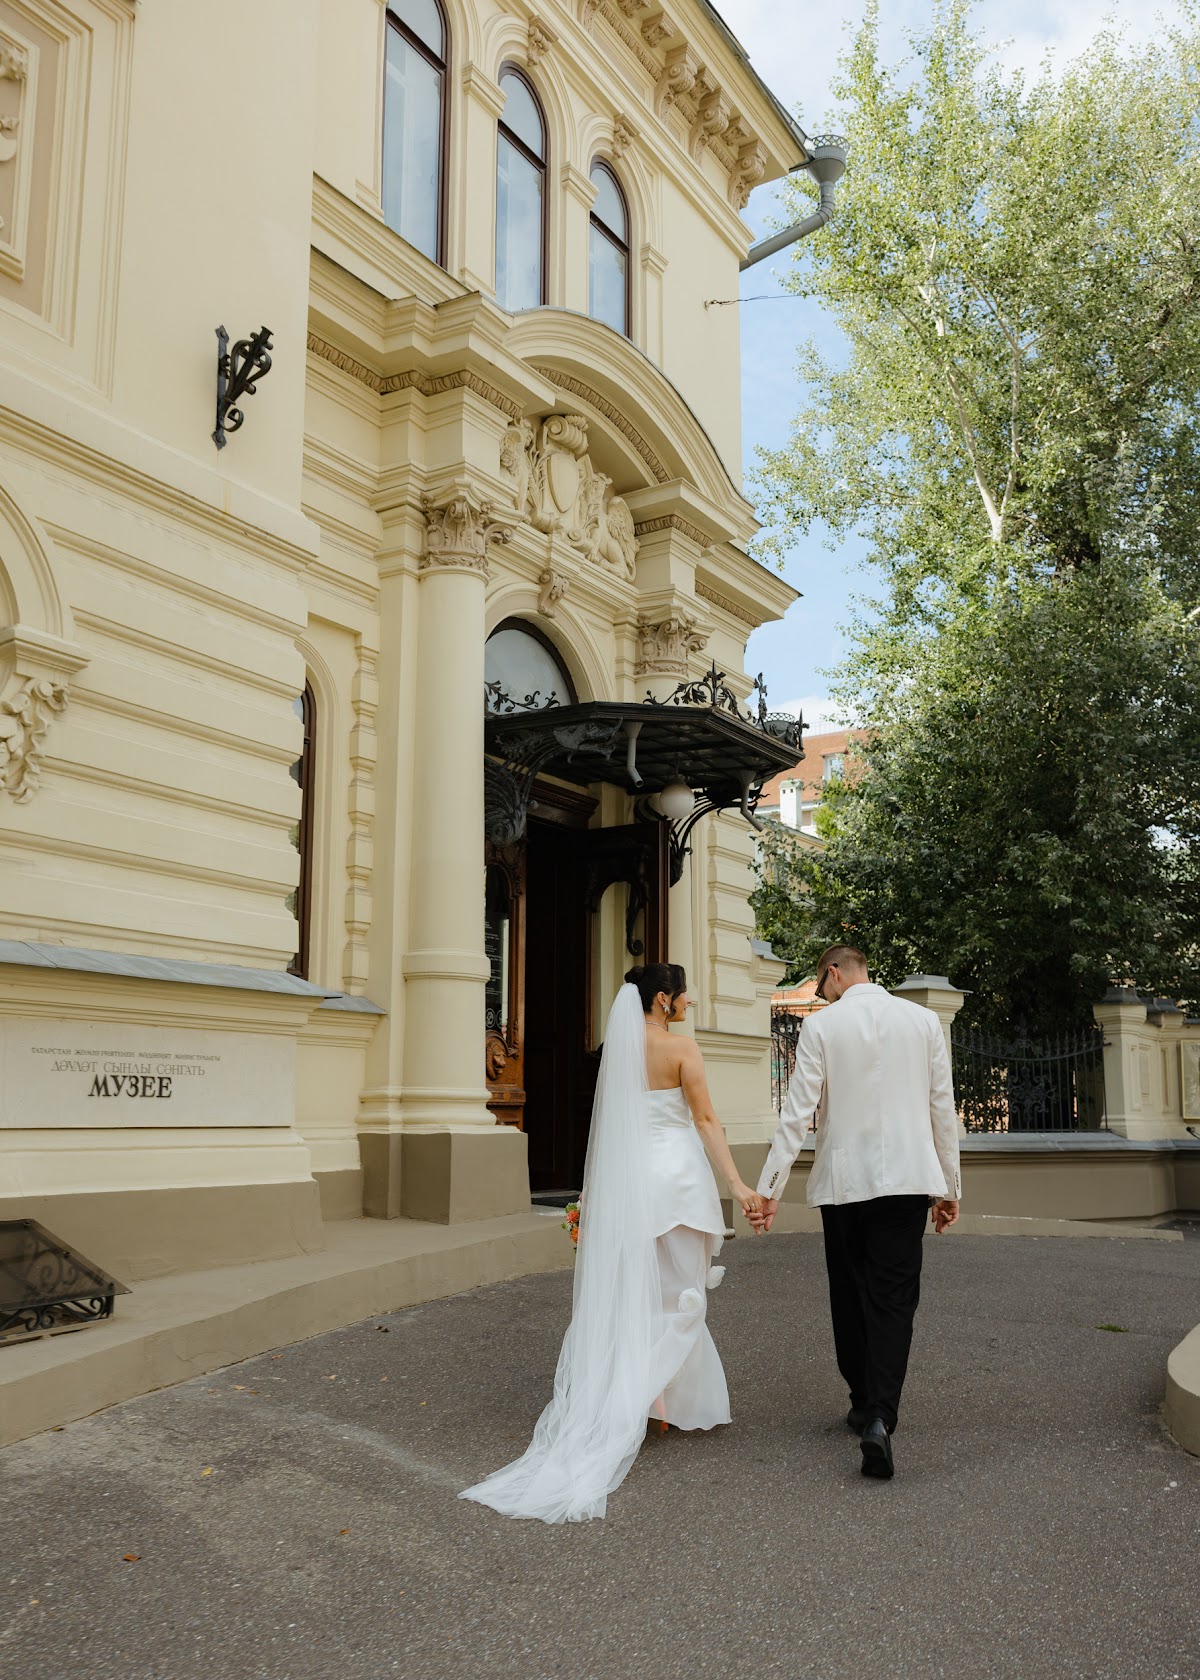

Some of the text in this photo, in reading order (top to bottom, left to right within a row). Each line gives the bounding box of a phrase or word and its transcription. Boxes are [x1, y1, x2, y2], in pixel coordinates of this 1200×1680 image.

[103, 1061, 151, 1074] СЫНЛЫ
[156, 1063, 206, 1076] СӘНГАТЬ
[87, 1074, 173, 1098] МУЗЕЕ
